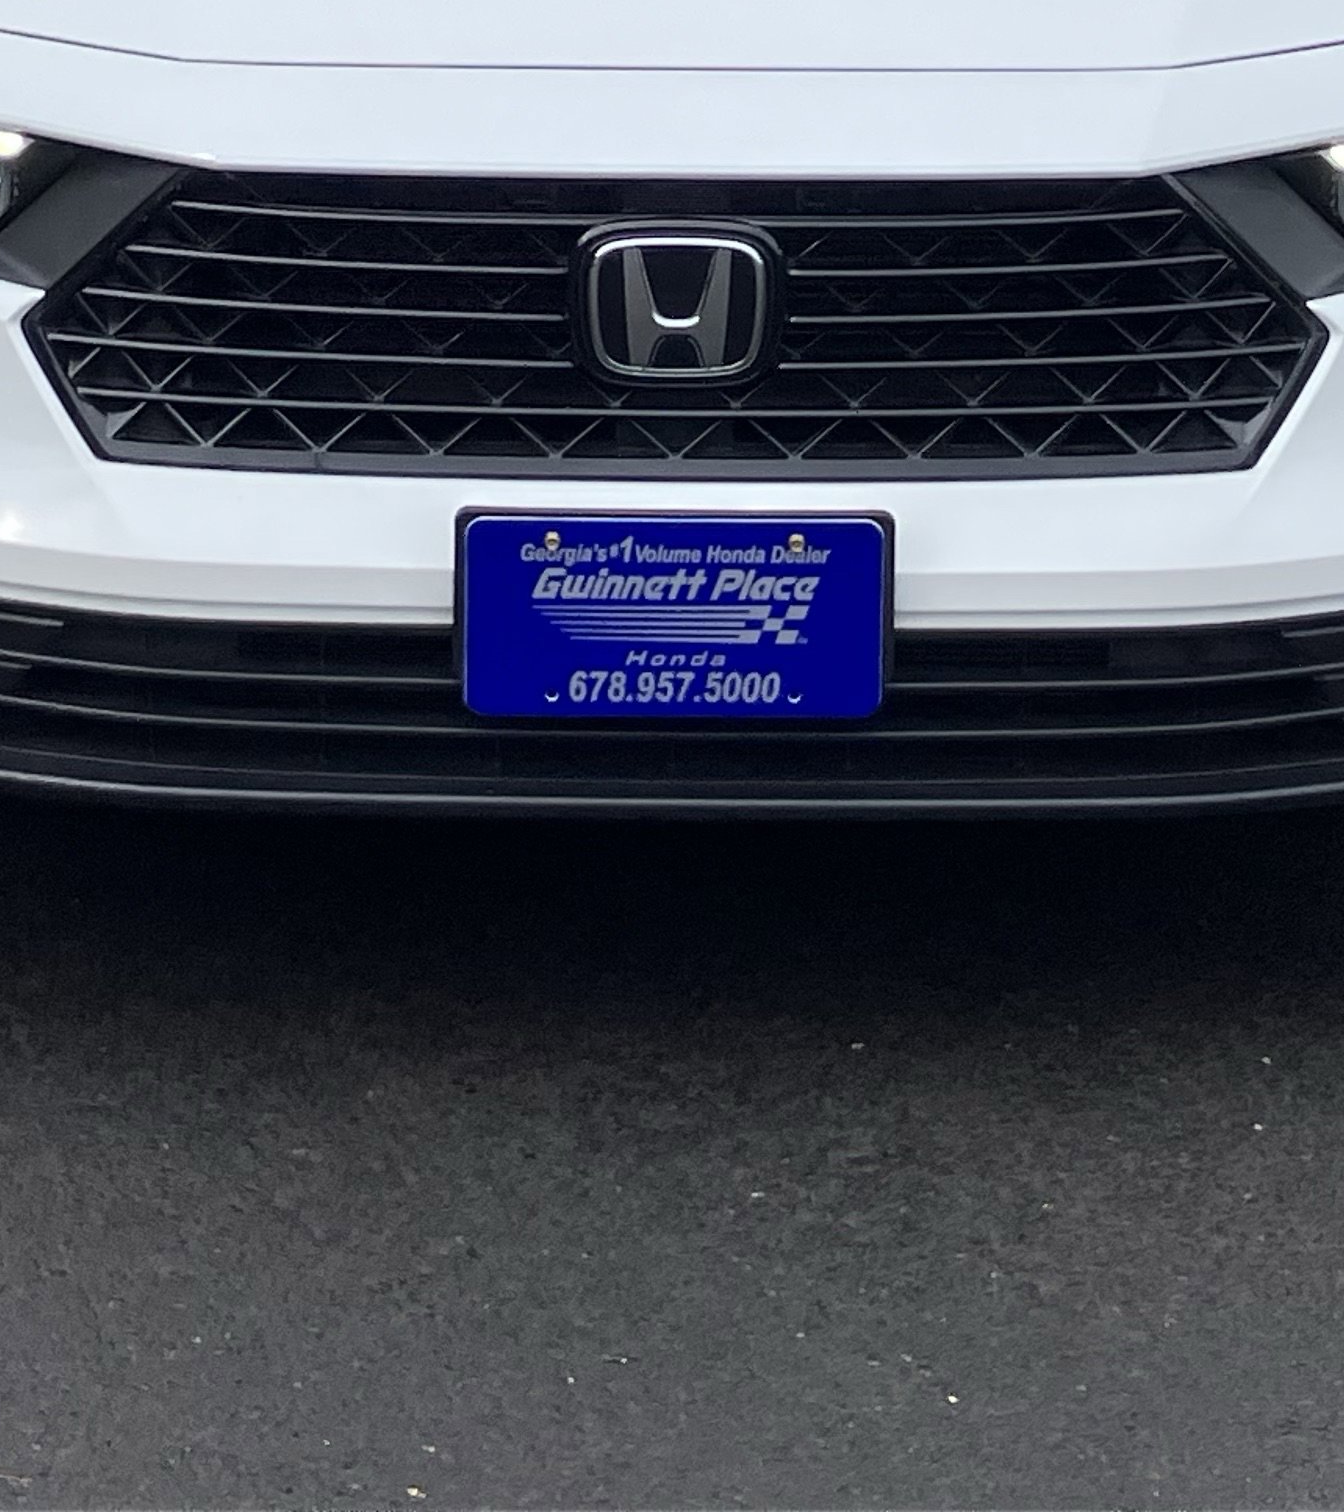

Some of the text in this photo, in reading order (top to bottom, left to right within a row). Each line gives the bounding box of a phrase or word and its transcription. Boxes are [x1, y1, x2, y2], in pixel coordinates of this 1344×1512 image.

[520, 543, 607, 567] Georgia's
[635, 544, 702, 564] Volume
[706, 544, 766, 564] Honda
[770, 545, 832, 564] Dealer
[531, 567, 821, 602] Gwinnett Place
[624, 649, 727, 667] Honda
[568, 670, 781, 704] 678.957.5000
